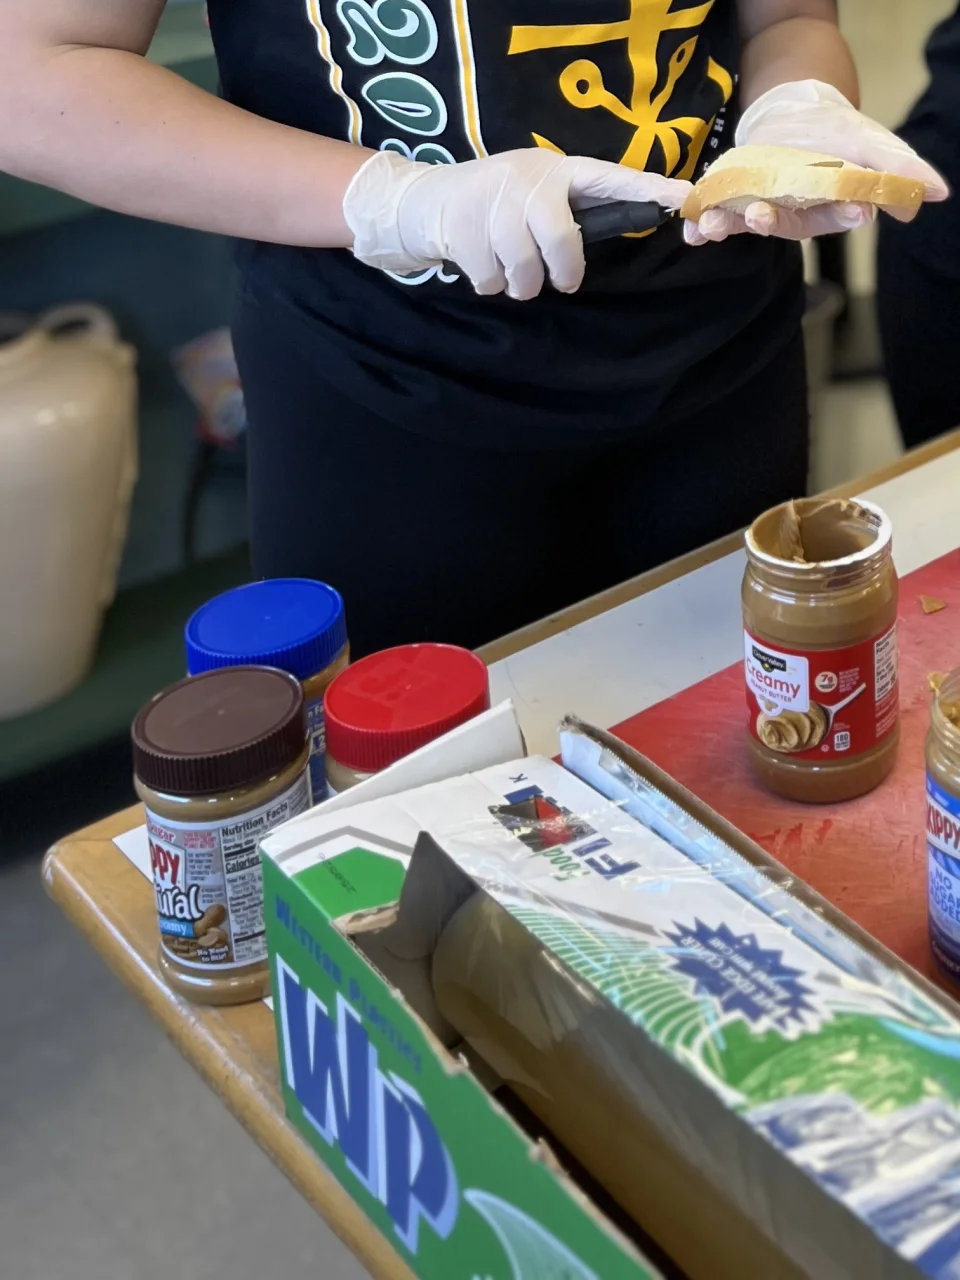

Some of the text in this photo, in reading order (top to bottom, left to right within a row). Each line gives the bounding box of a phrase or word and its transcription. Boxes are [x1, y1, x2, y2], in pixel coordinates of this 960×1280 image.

[746, 657, 801, 698] Creamy
[769, 690, 792, 703] BUTTER
[222, 817, 264, 837] Nutrition
[266, 802, 288, 821] Facts
[936, 868, 953, 890] NO
[721, 967, 756, 993] EDGE
